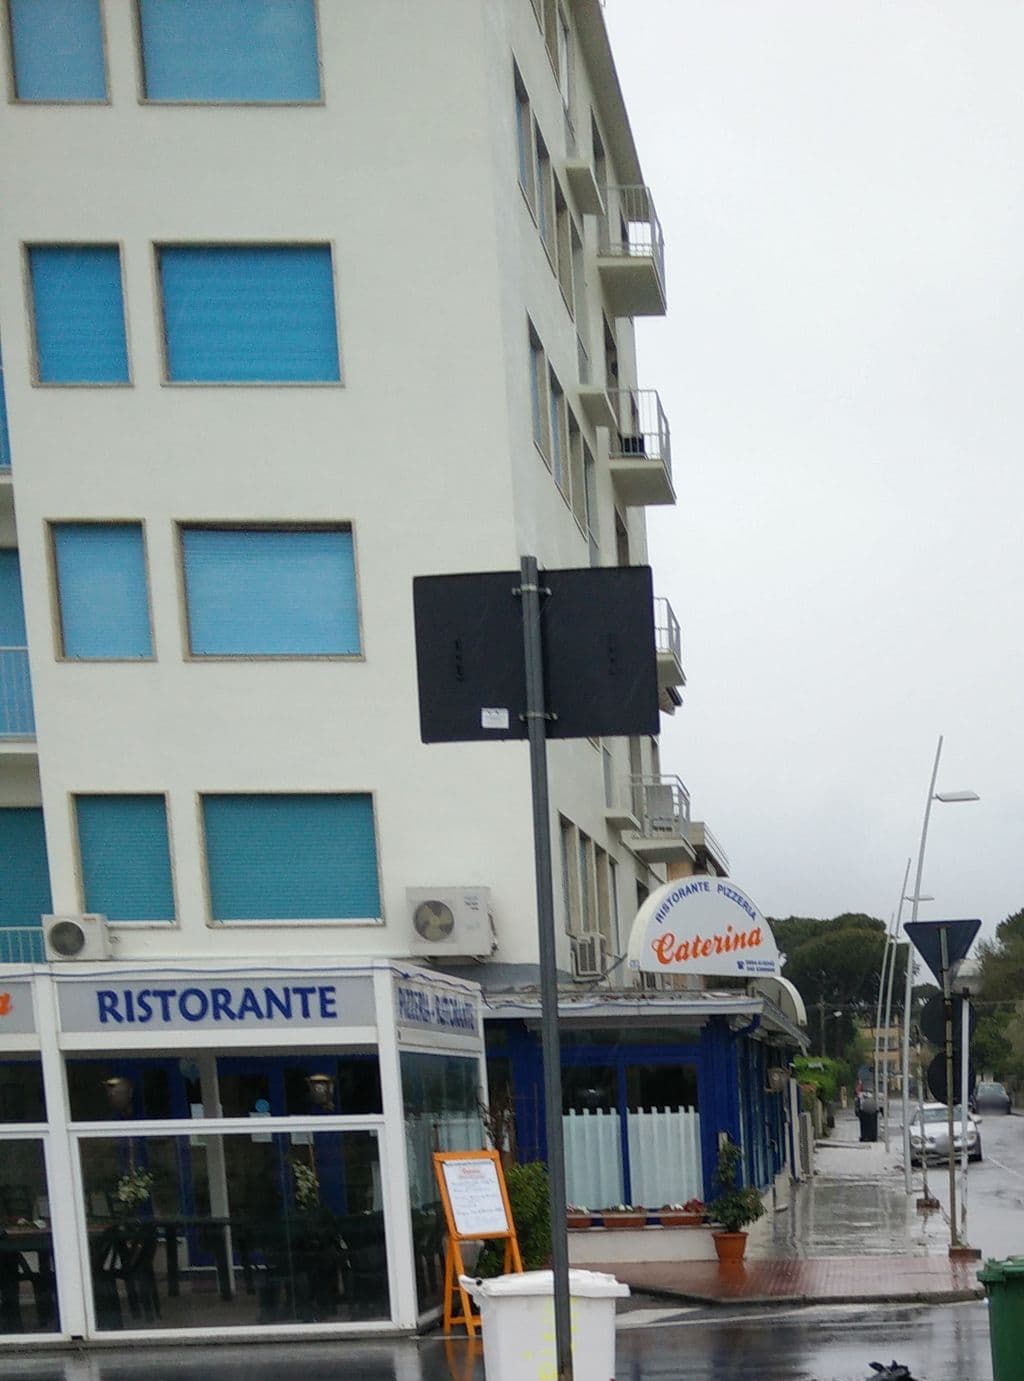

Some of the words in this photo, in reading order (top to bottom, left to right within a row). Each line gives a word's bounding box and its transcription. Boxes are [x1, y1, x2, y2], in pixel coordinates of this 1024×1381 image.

[655, 881, 711, 925] RISTORANTE
[716, 883, 757, 922] PIZZERIA
[651, 925, 762, 965] Caterina
[96, 985, 338, 1024] RISTORANTE
